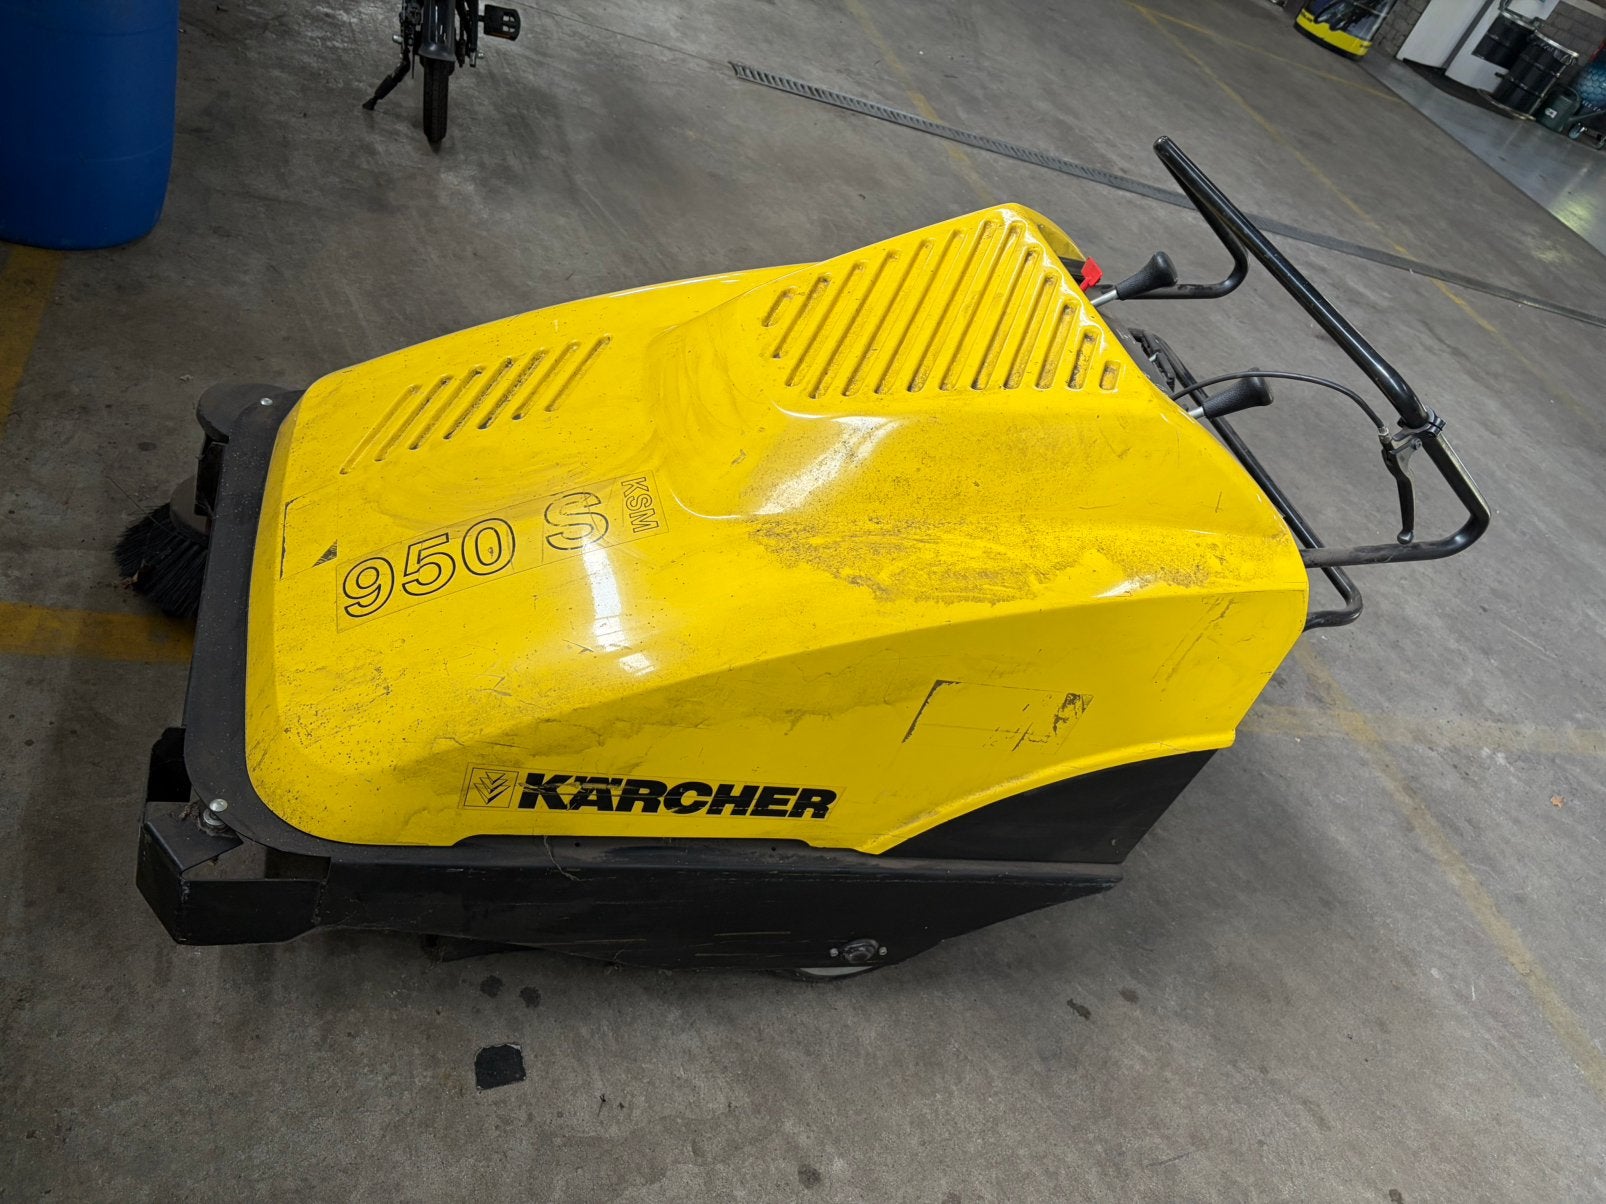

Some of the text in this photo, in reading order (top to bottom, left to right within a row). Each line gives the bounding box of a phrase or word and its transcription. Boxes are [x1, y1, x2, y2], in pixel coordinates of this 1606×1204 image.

[620, 476, 660, 534] KSM
[342, 491, 610, 619] 950 S
[517, 772, 838, 820] KÄRCHER
